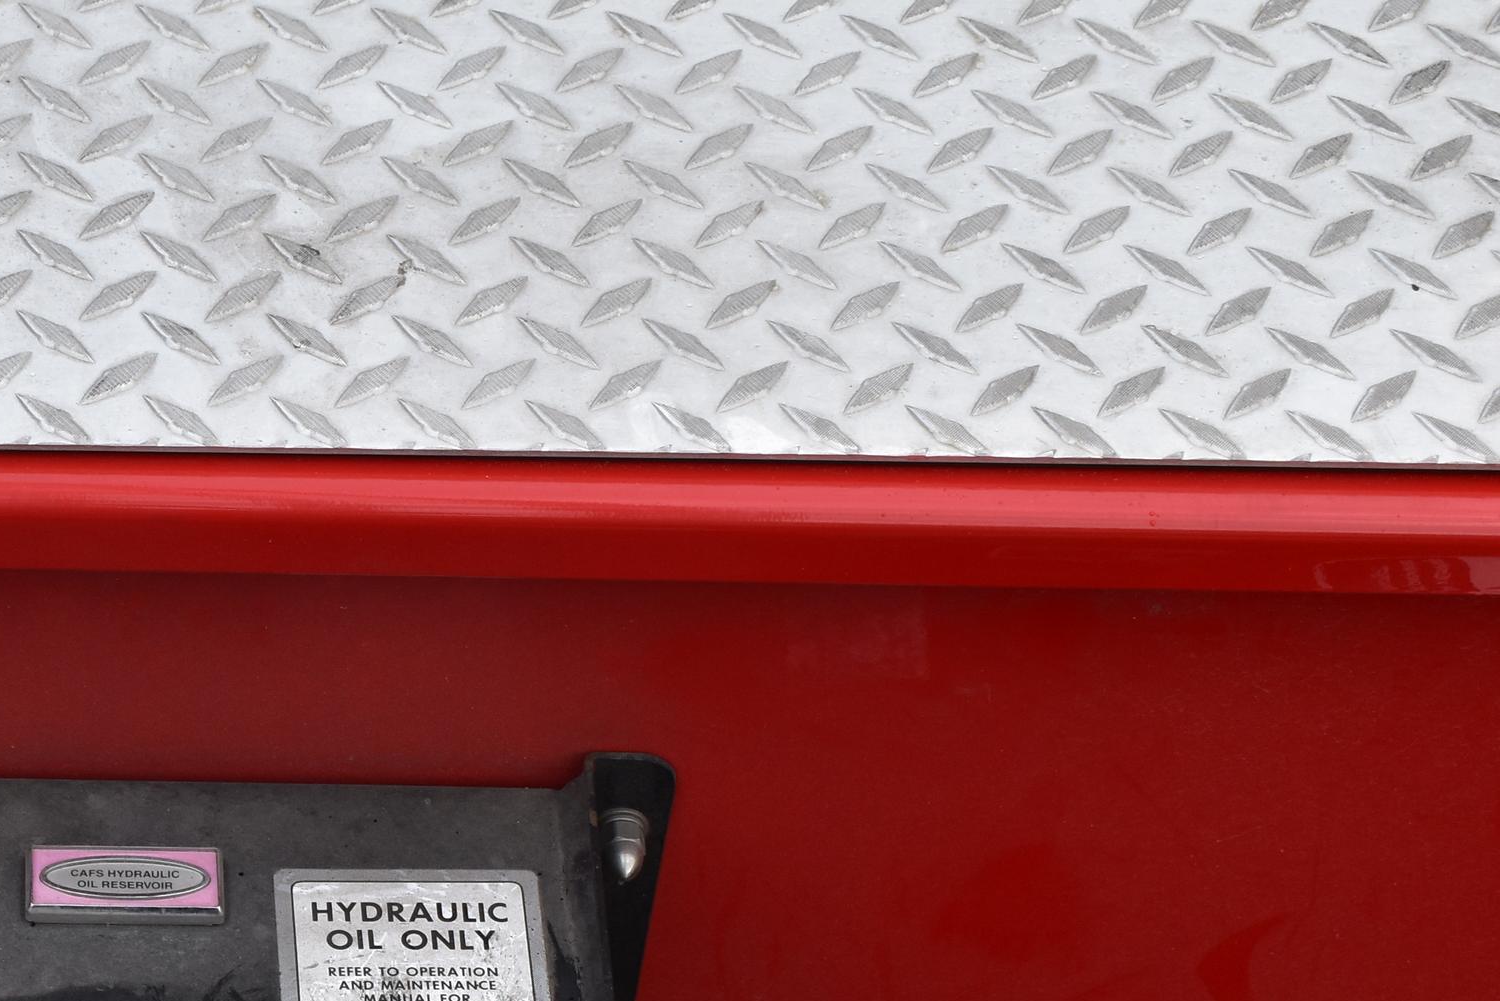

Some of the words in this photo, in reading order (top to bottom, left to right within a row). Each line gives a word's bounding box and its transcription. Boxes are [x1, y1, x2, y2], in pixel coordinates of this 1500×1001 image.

[70, 869, 104, 877] CAFS
[107, 870, 180, 879] HYDRAULIC
[77, 880, 98, 888] OIL
[101, 880, 173, 890] RESERVOIR
[310, 901, 509, 923] HYDRAULIC
[326, 929, 383, 950] OIL
[400, 929, 496, 951] ONLY
[328, 966, 373, 977] REFER
[378, 966, 400, 977] TO
[406, 966, 499, 977] OPERATION
[339, 980, 374, 990] AND
[381, 980, 497, 991] MAINTENANCE
